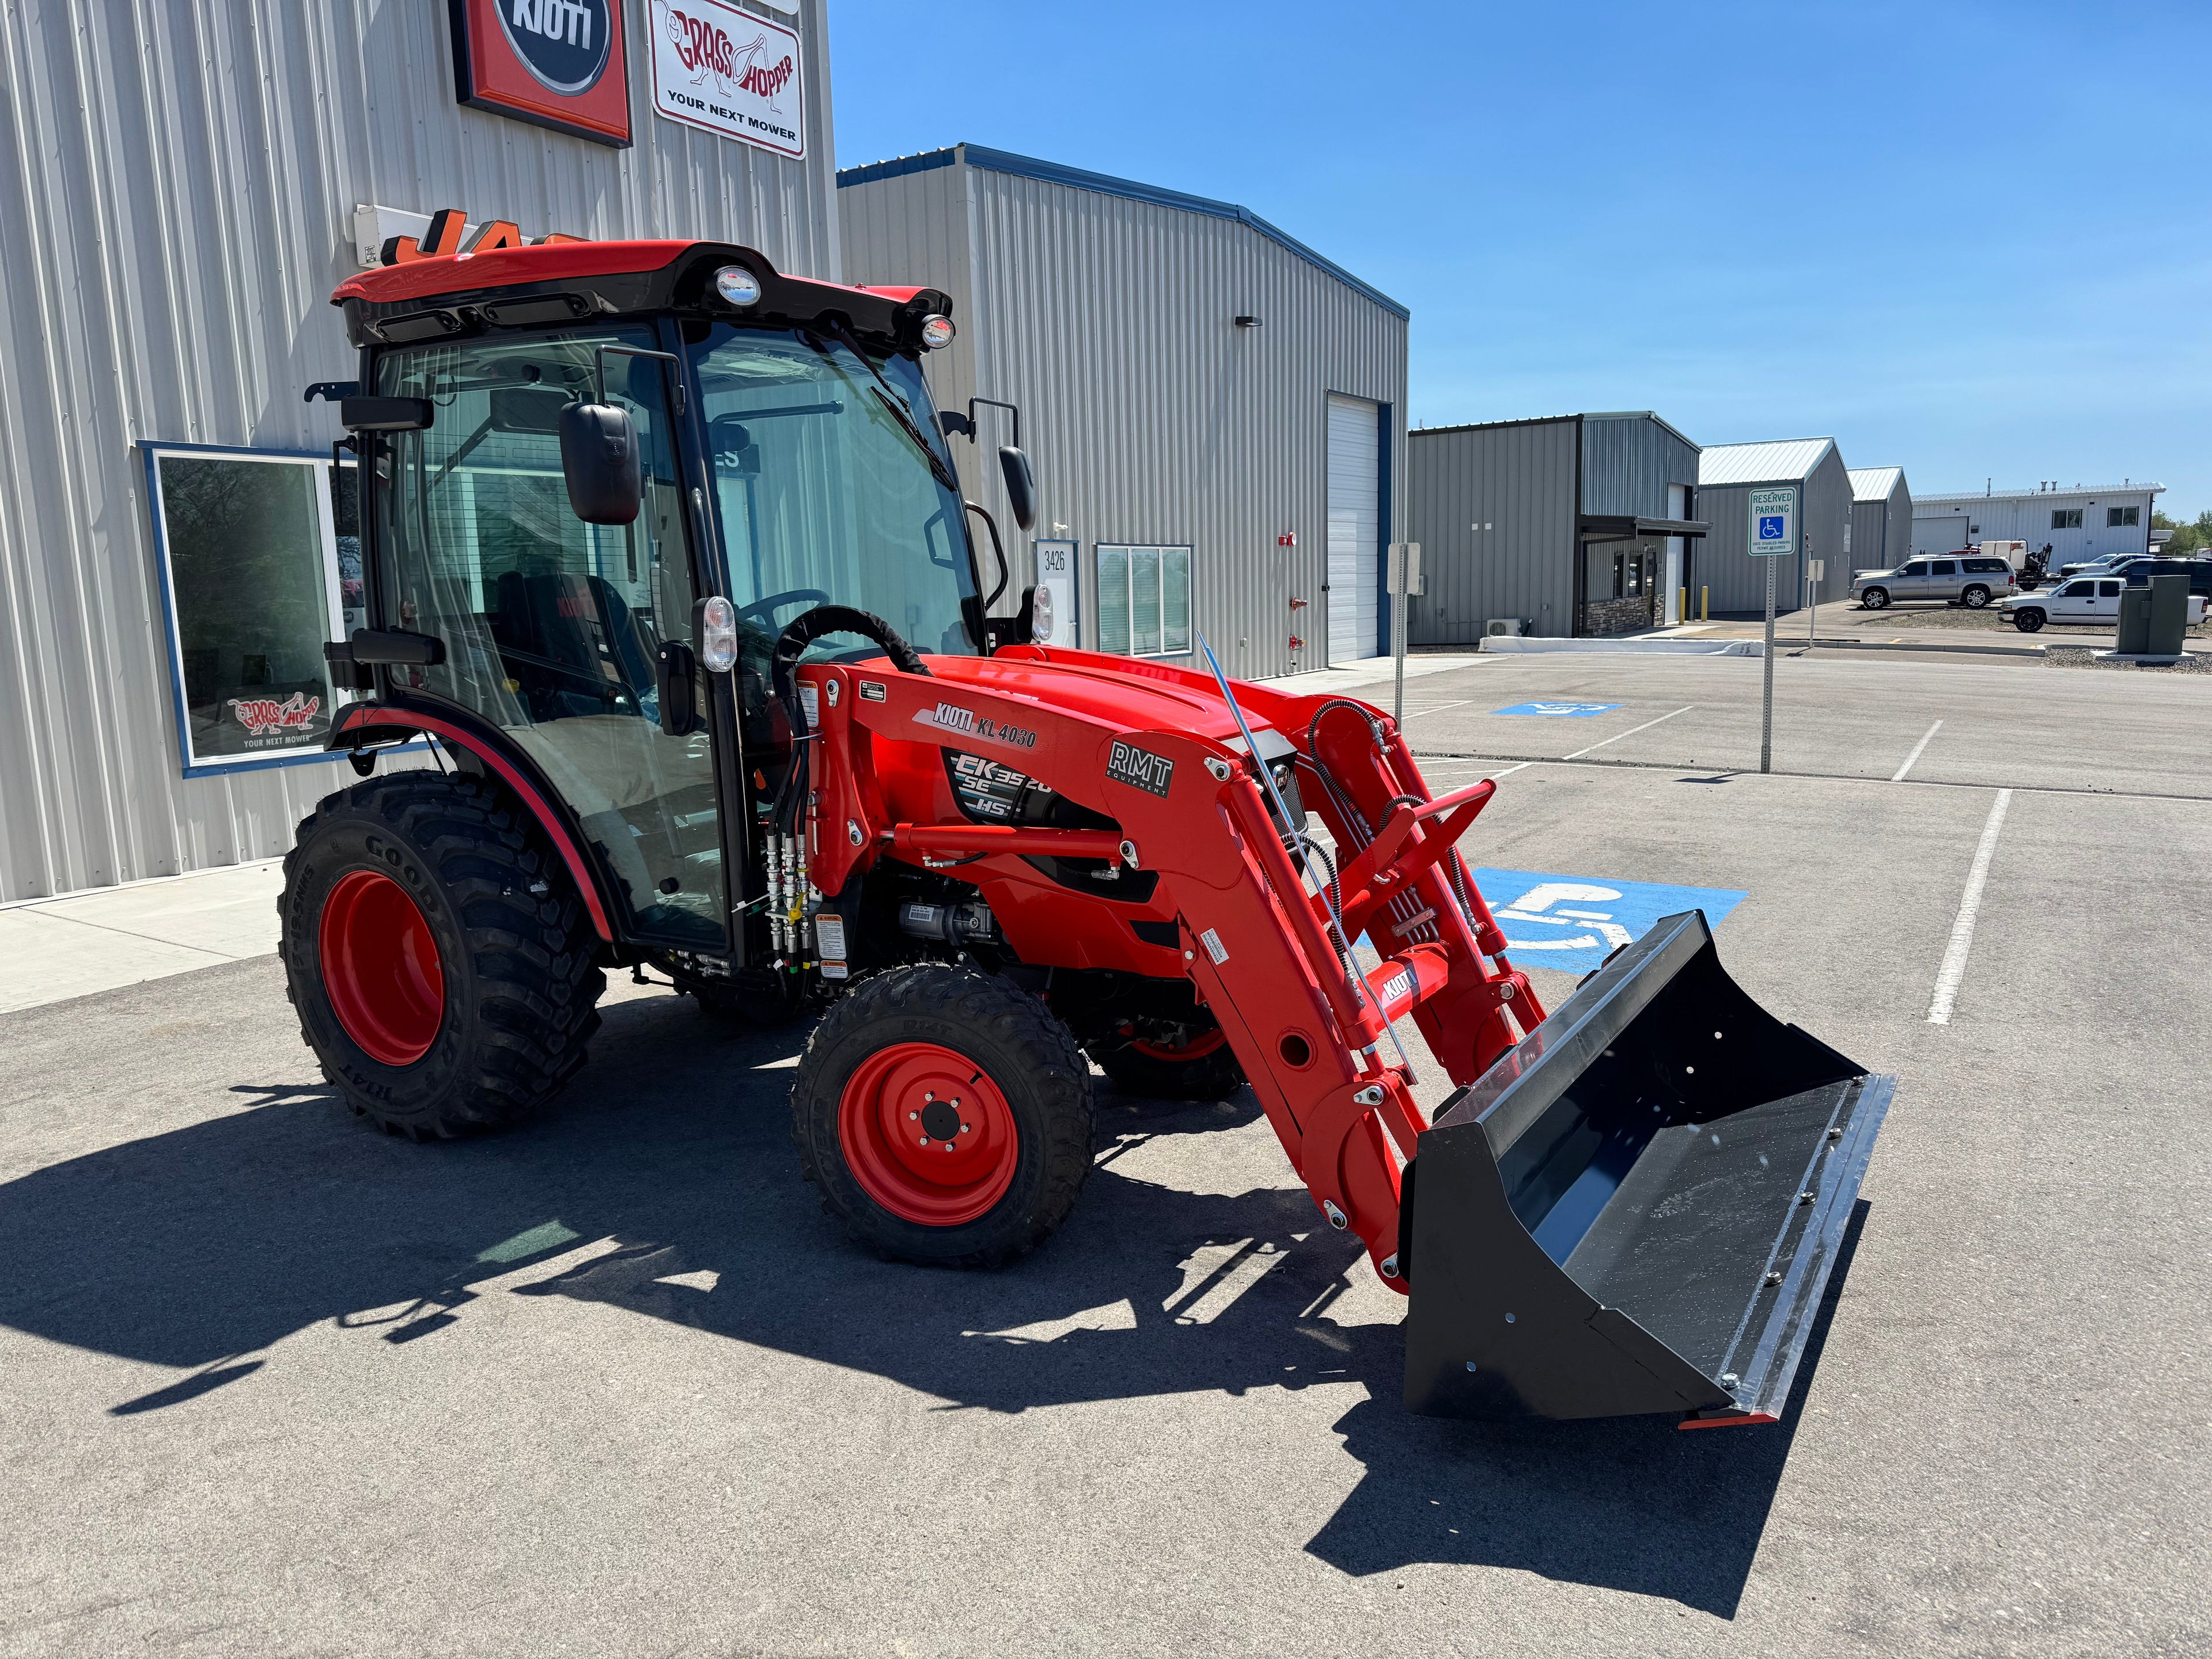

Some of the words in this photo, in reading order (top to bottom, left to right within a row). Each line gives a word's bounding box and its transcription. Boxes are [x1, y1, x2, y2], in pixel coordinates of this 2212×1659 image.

[513, 0, 592, 50] KIOTI
[668, 90, 705, 111] YOUR
[710, 104, 744, 123] NEXT
[748, 117, 796, 141] MOWER
[381, 209, 593, 265] JA
[1753, 493, 1792, 503] RESERVED
[1755, 505, 1789, 514] PARKING
[1045, 551, 1065, 571] 3426
[933, 701, 975, 732] KIOTI
[976, 718, 995, 738] KL
[998, 724, 1037, 749] 4030
[244, 739, 263, 748] YOUR
[266, 737, 282, 745] NEXT
[1108, 741, 1173, 787] RMT
[963, 775, 992, 793] SE
[1107, 770, 1165, 796] EQUIPMENT
[1382, 968, 1418, 1000] KIOTI
